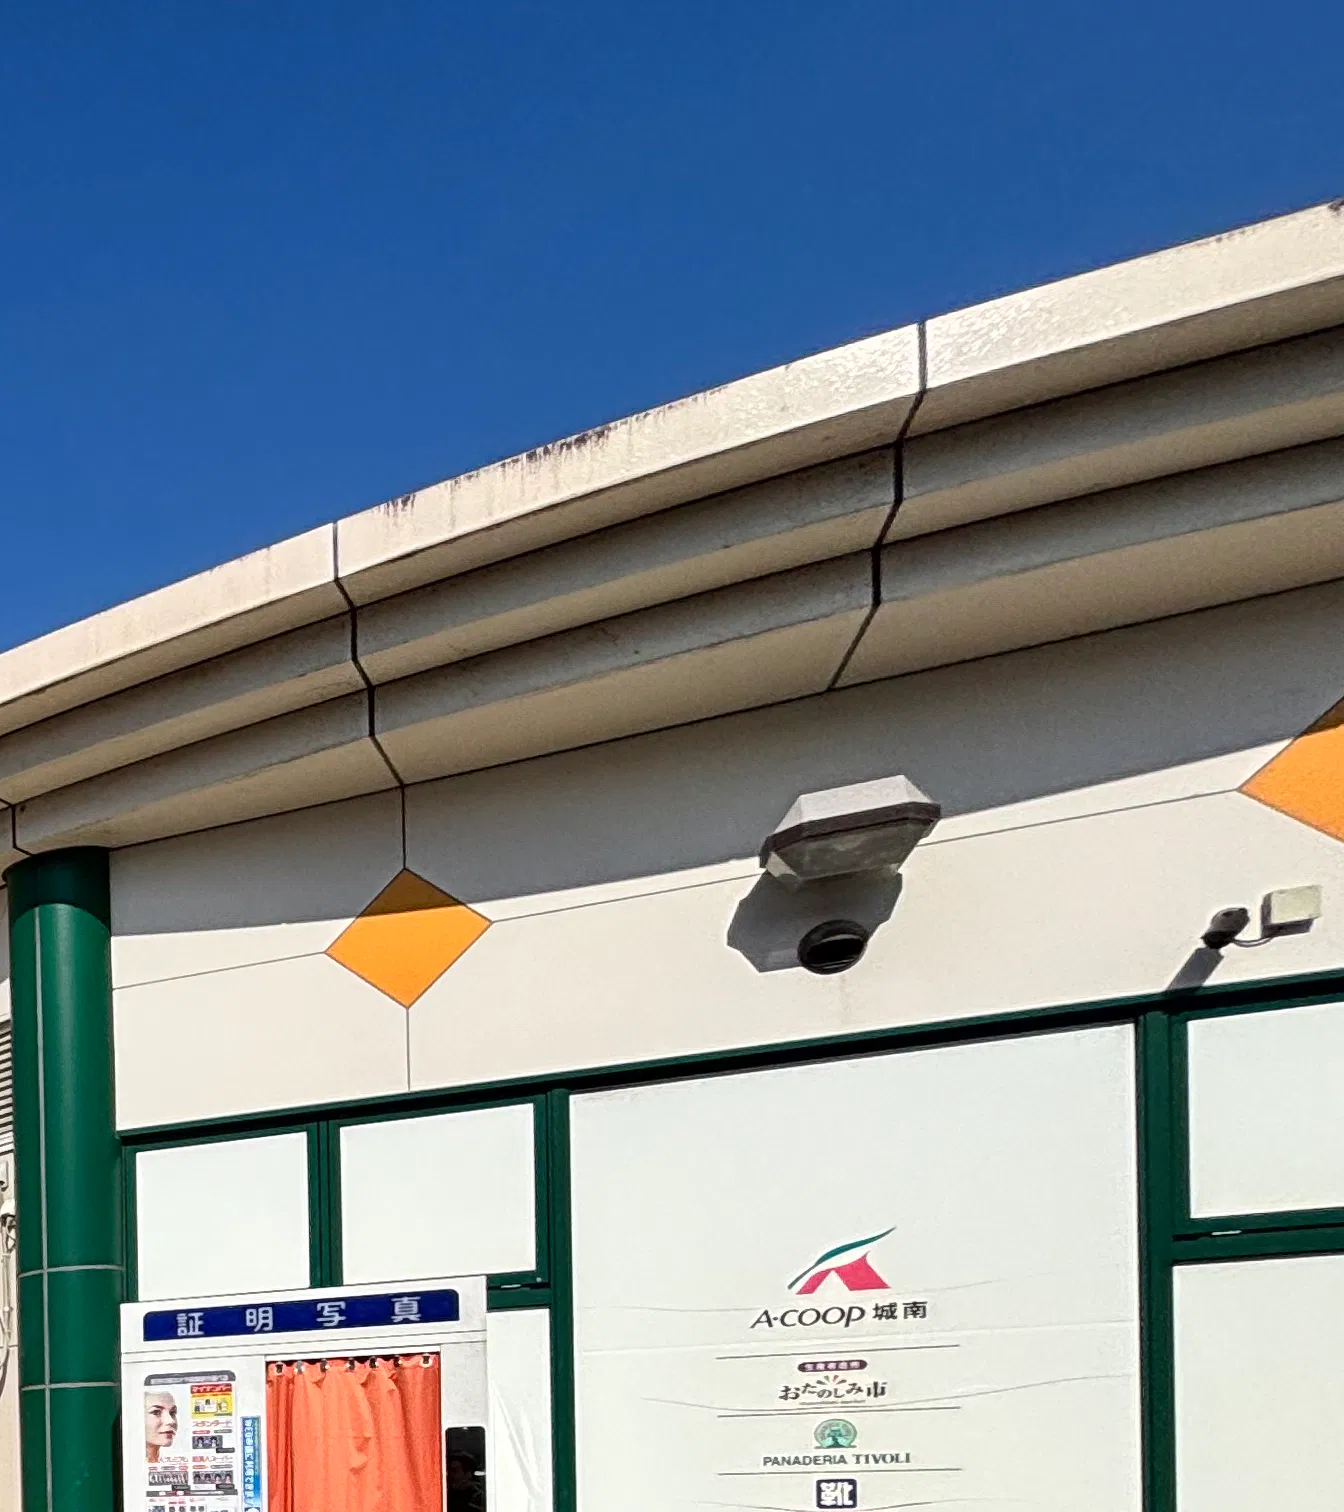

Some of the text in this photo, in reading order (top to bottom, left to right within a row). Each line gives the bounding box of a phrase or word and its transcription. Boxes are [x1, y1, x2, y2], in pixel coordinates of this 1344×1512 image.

[176, 1296, 421, 1336] 証明写真
[872, 1301, 927, 1320] 城南
[778, 1381, 888, 1400] おたのしみ市
[762, 1453, 911, 1467] PANADERIA TIVOLI
